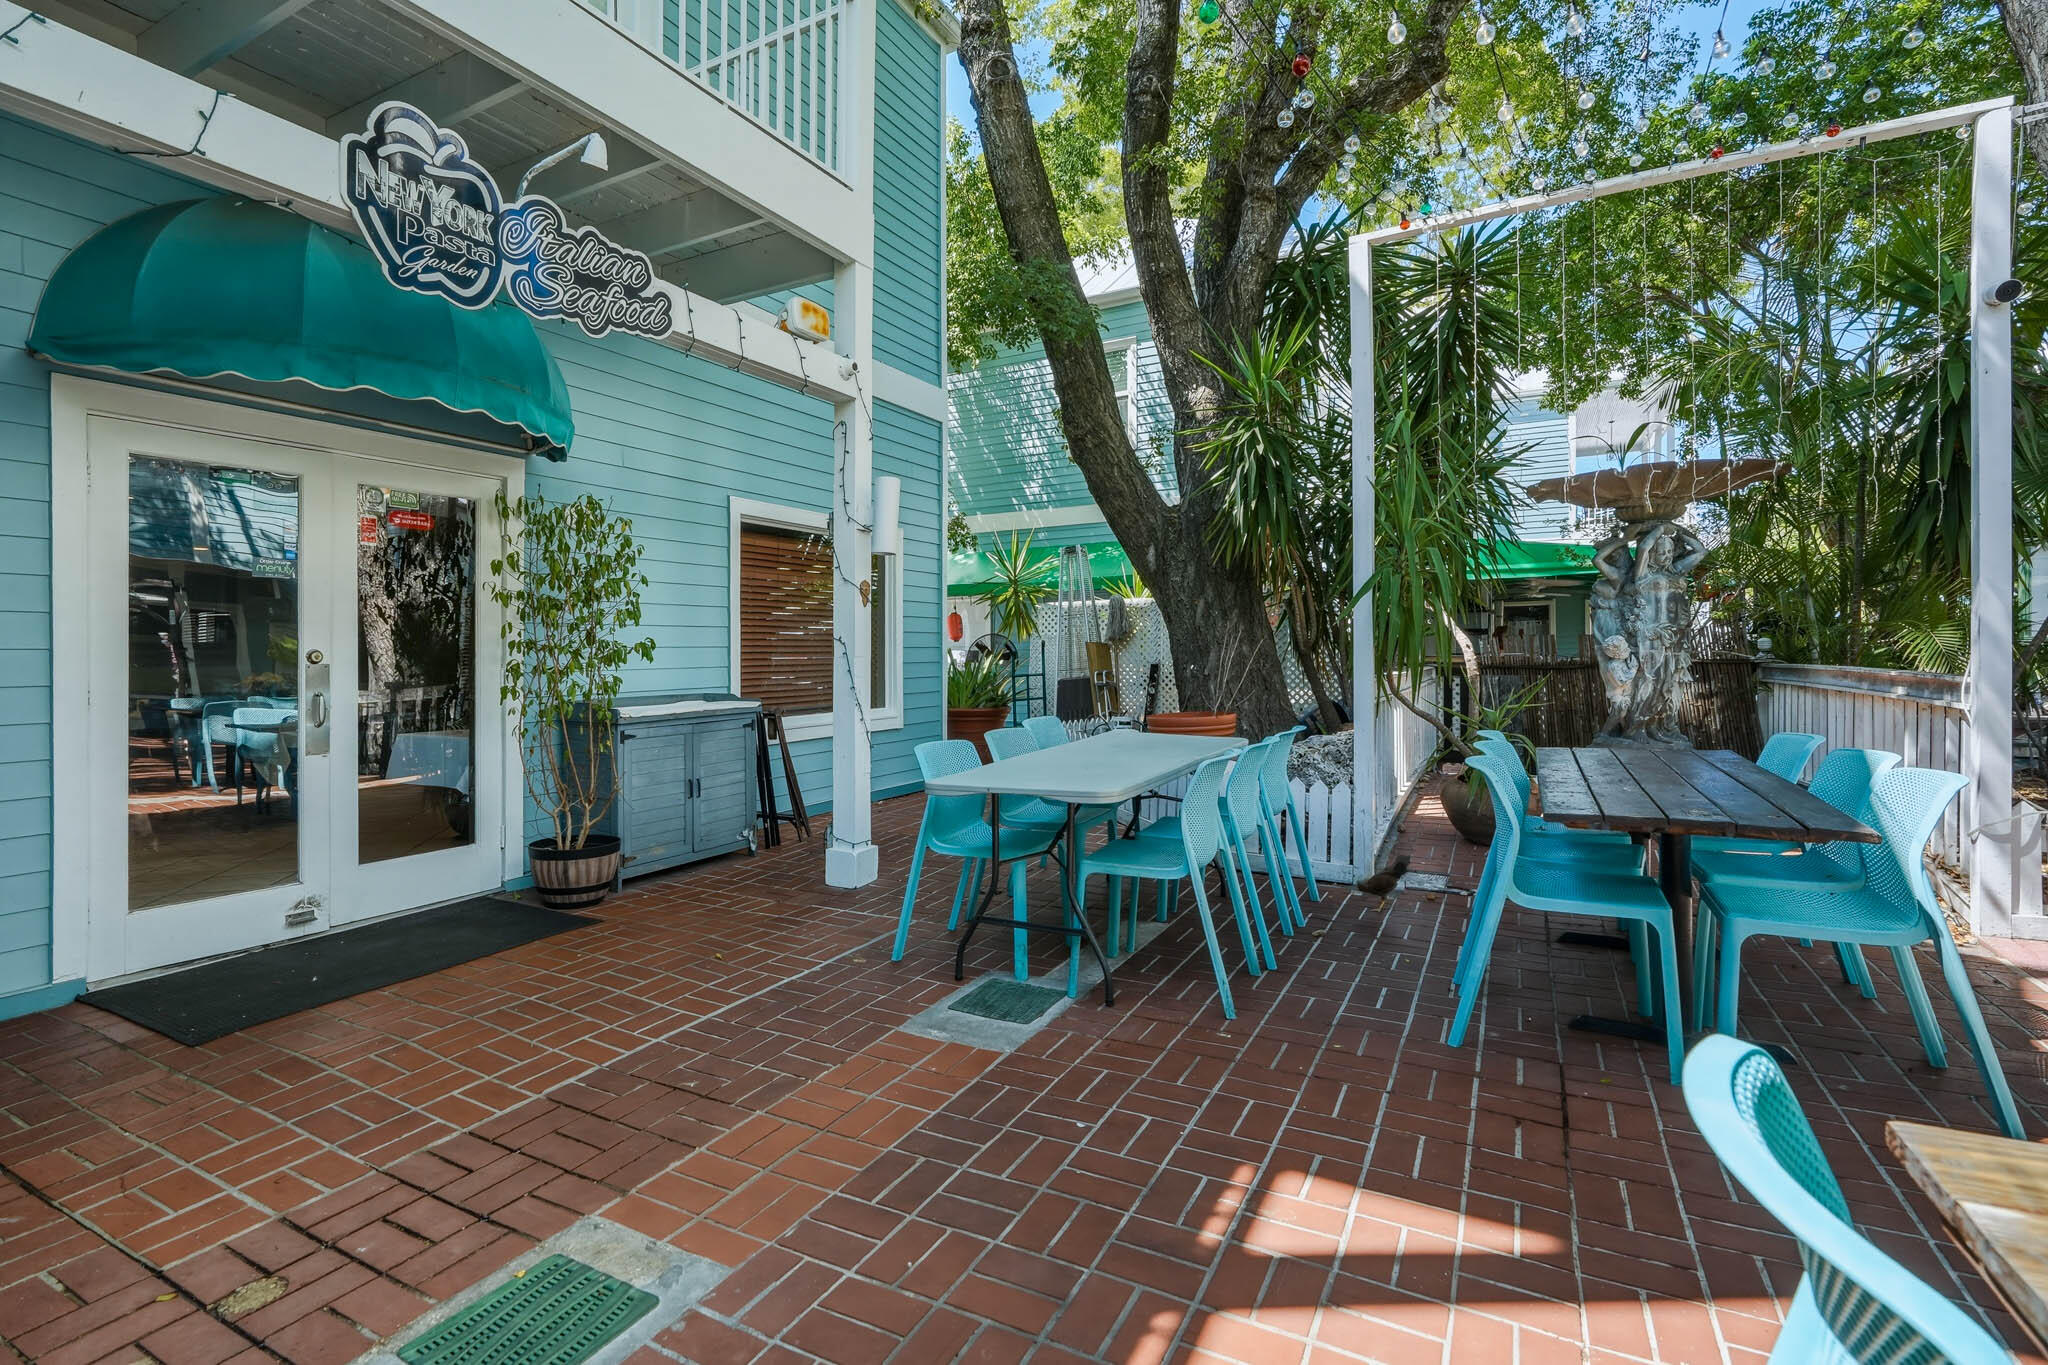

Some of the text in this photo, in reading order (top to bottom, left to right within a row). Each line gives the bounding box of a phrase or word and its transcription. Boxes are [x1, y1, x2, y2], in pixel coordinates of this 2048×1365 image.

[356, 149, 494, 245] NEW YORK
[397, 208, 496, 266] Pasta
[398, 245, 480, 277] Garden
[499, 206, 647, 287] Italian
[516, 262, 669, 331] Seafood
